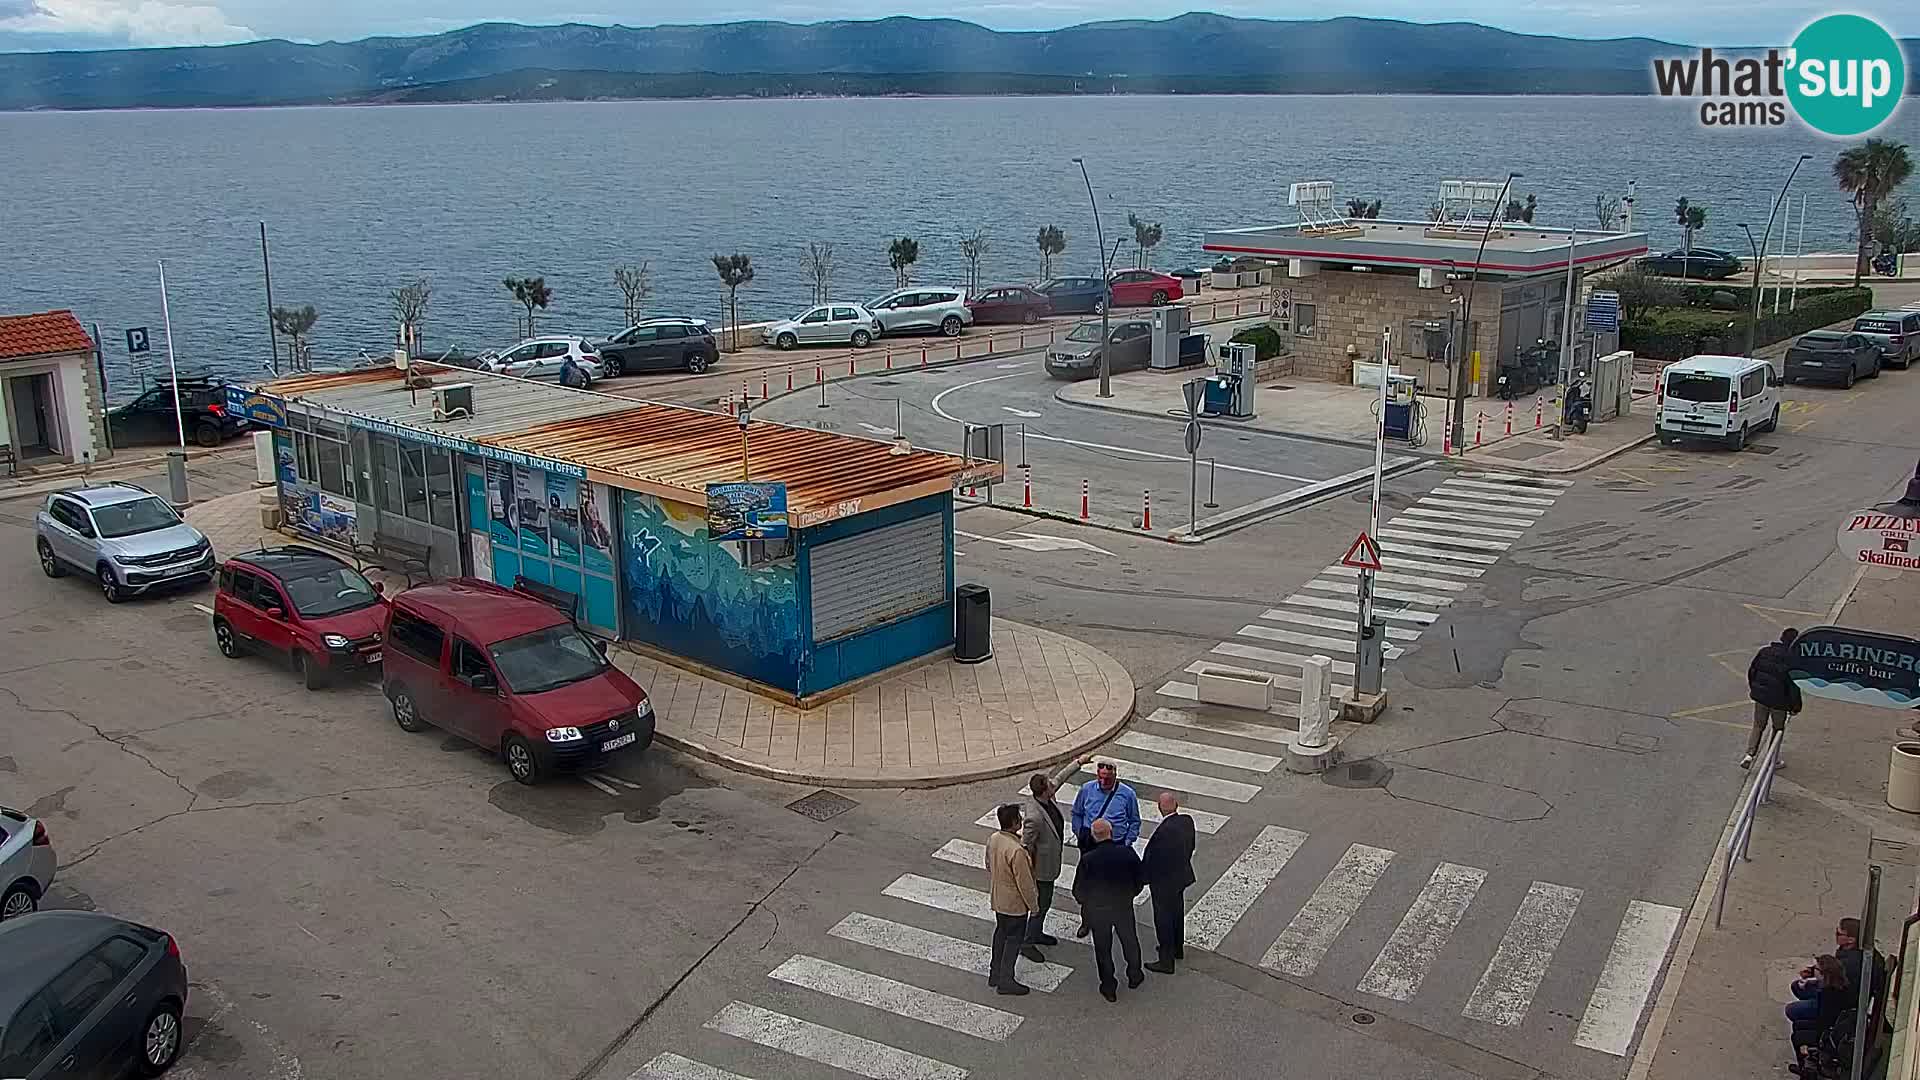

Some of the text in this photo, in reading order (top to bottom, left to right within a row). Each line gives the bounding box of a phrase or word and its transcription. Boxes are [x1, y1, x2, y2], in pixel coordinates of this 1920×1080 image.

[131, 331, 144, 350] P
[437, 436, 469, 450] POSTAJA
[478, 445, 494, 457] BUS
[494, 449, 527, 464] STATION
[529, 457, 555, 470] TICKET
[556, 462, 583, 476] OFFICE
[1880, 530, 1915, 541] GRILL
[1828, 661, 1896, 680] caffe bar
